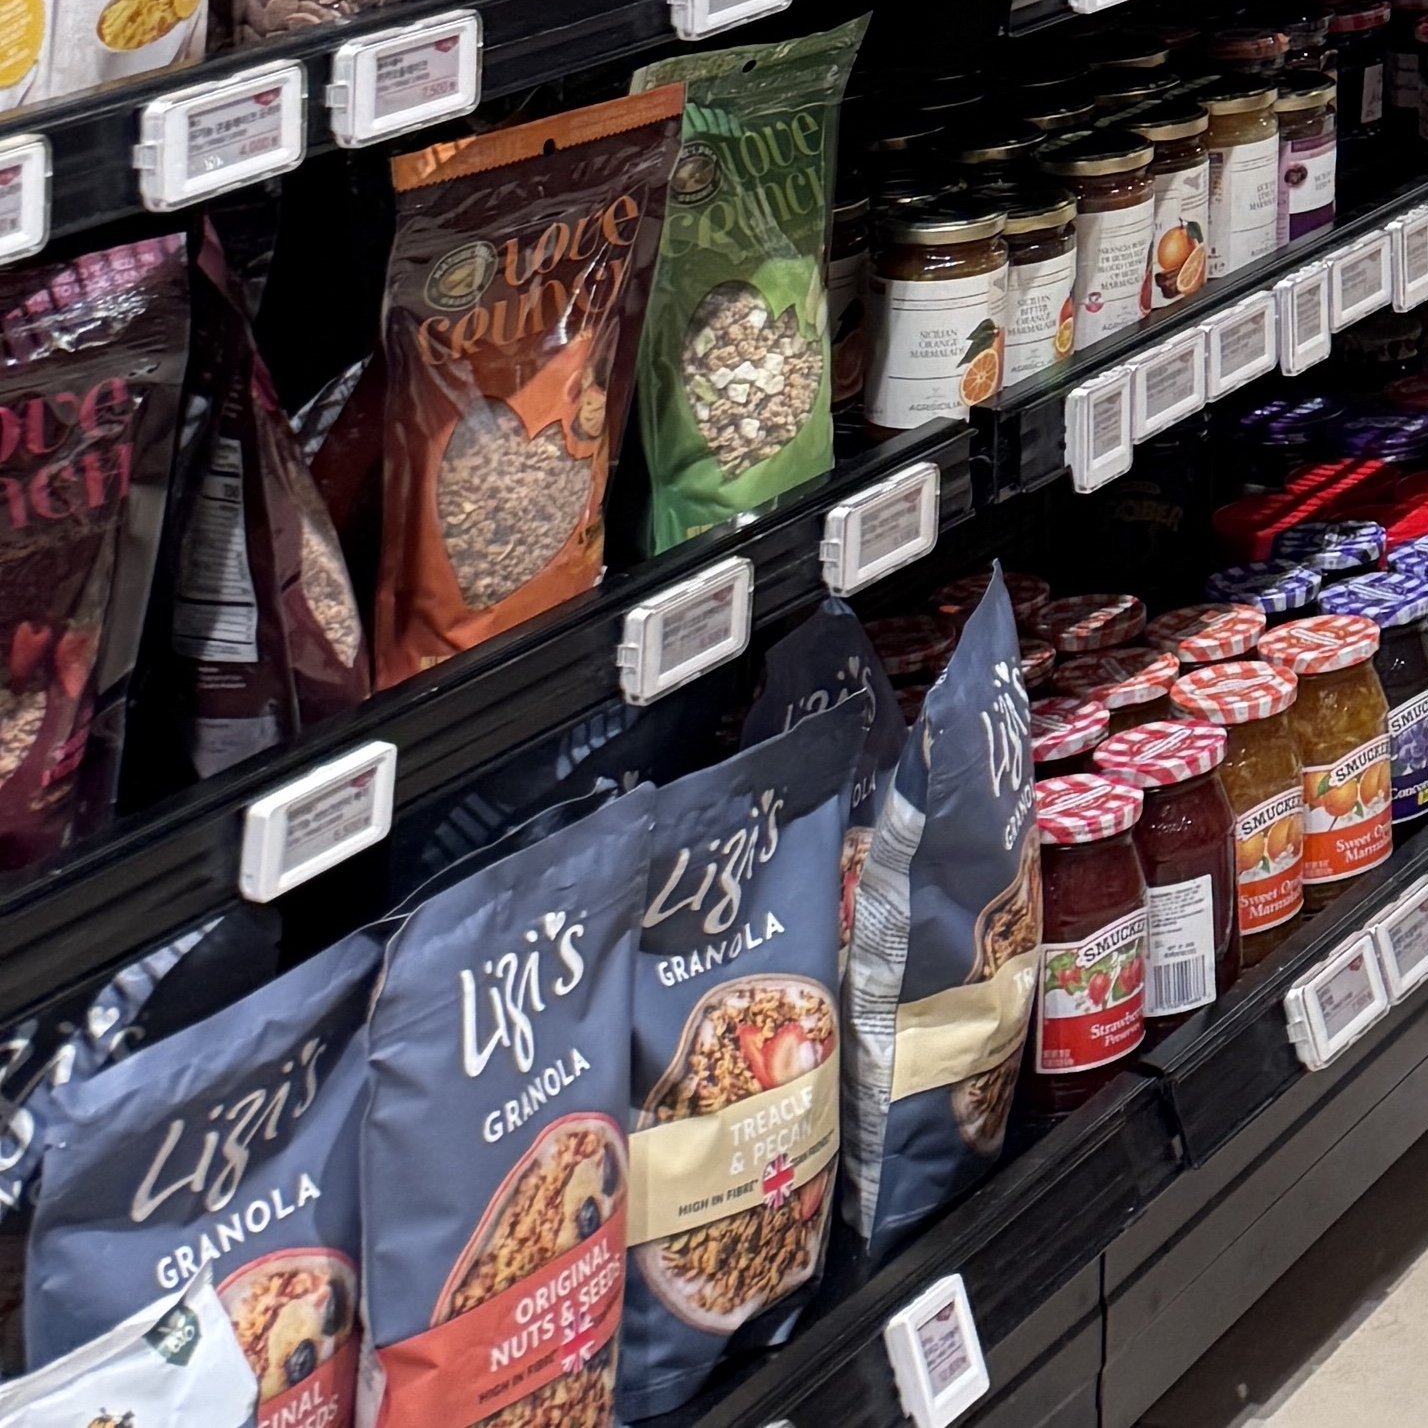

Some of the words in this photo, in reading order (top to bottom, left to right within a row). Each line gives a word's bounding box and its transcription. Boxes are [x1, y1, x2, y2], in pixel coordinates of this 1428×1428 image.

[642, 799, 784, 934] Lizi's
[458, 924, 587, 1078] Lizi's
[657, 911, 786, 988] GRANOLA
[131, 1038, 327, 1224] Lizi's
[482, 1048, 591, 1145] GRANOLA
[729, 1151, 746, 1176] &
[752, 1119, 813, 1166] PECAN
[730, 1086, 814, 1146] TREACLE
[156, 1173, 322, 1291] GRANOLA
[514, 1238, 613, 1326] ORIGINAL
[489, 1315, 558, 1373] NUTS
[577, 1256, 622, 1316] SEEDS
